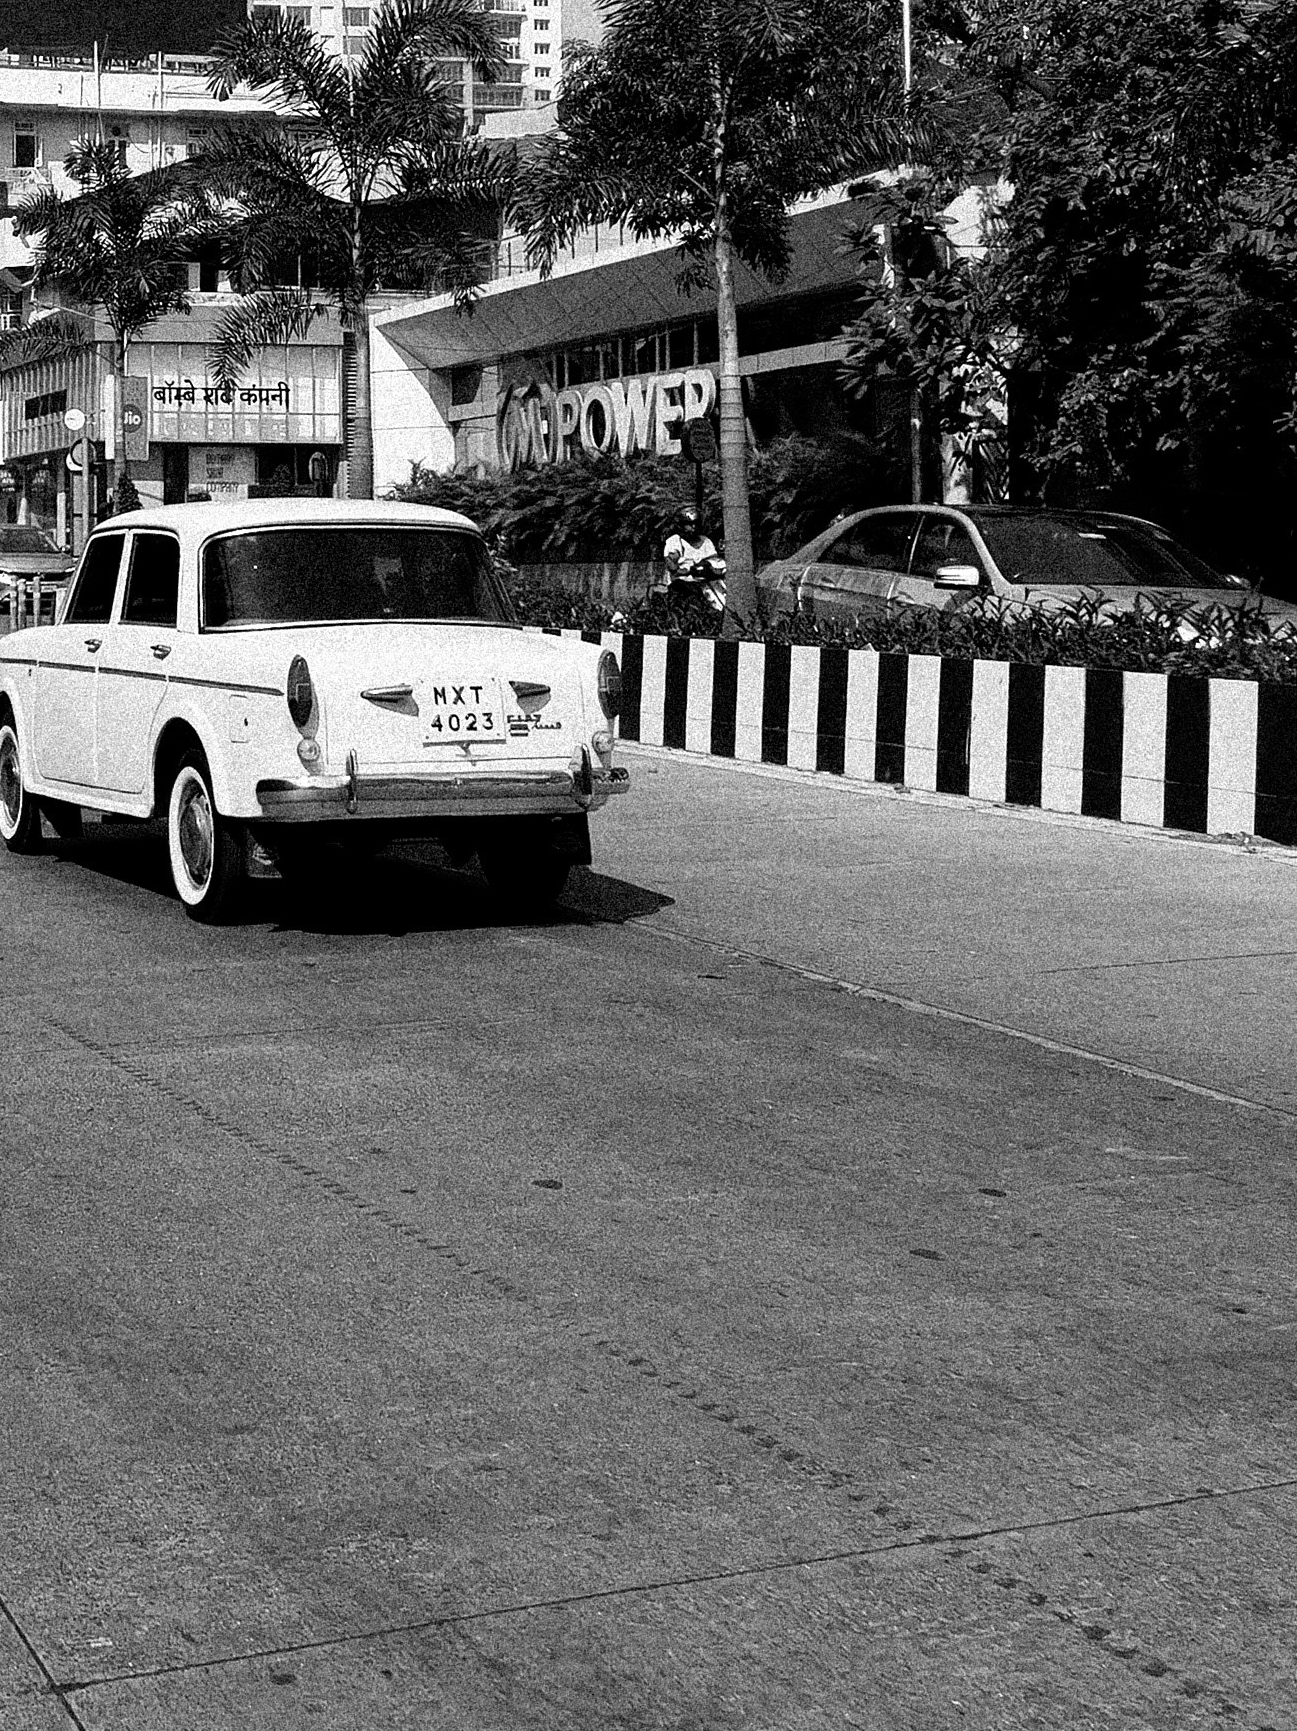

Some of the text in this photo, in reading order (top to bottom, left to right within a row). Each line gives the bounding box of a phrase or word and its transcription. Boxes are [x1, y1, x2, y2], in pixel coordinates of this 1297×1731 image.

[153, 379, 195, 407] बॉम्बे
[239, 381, 290, 408] कंपनी
[433, 686, 483, 705] MXT
[431, 712, 494, 732] 4023
